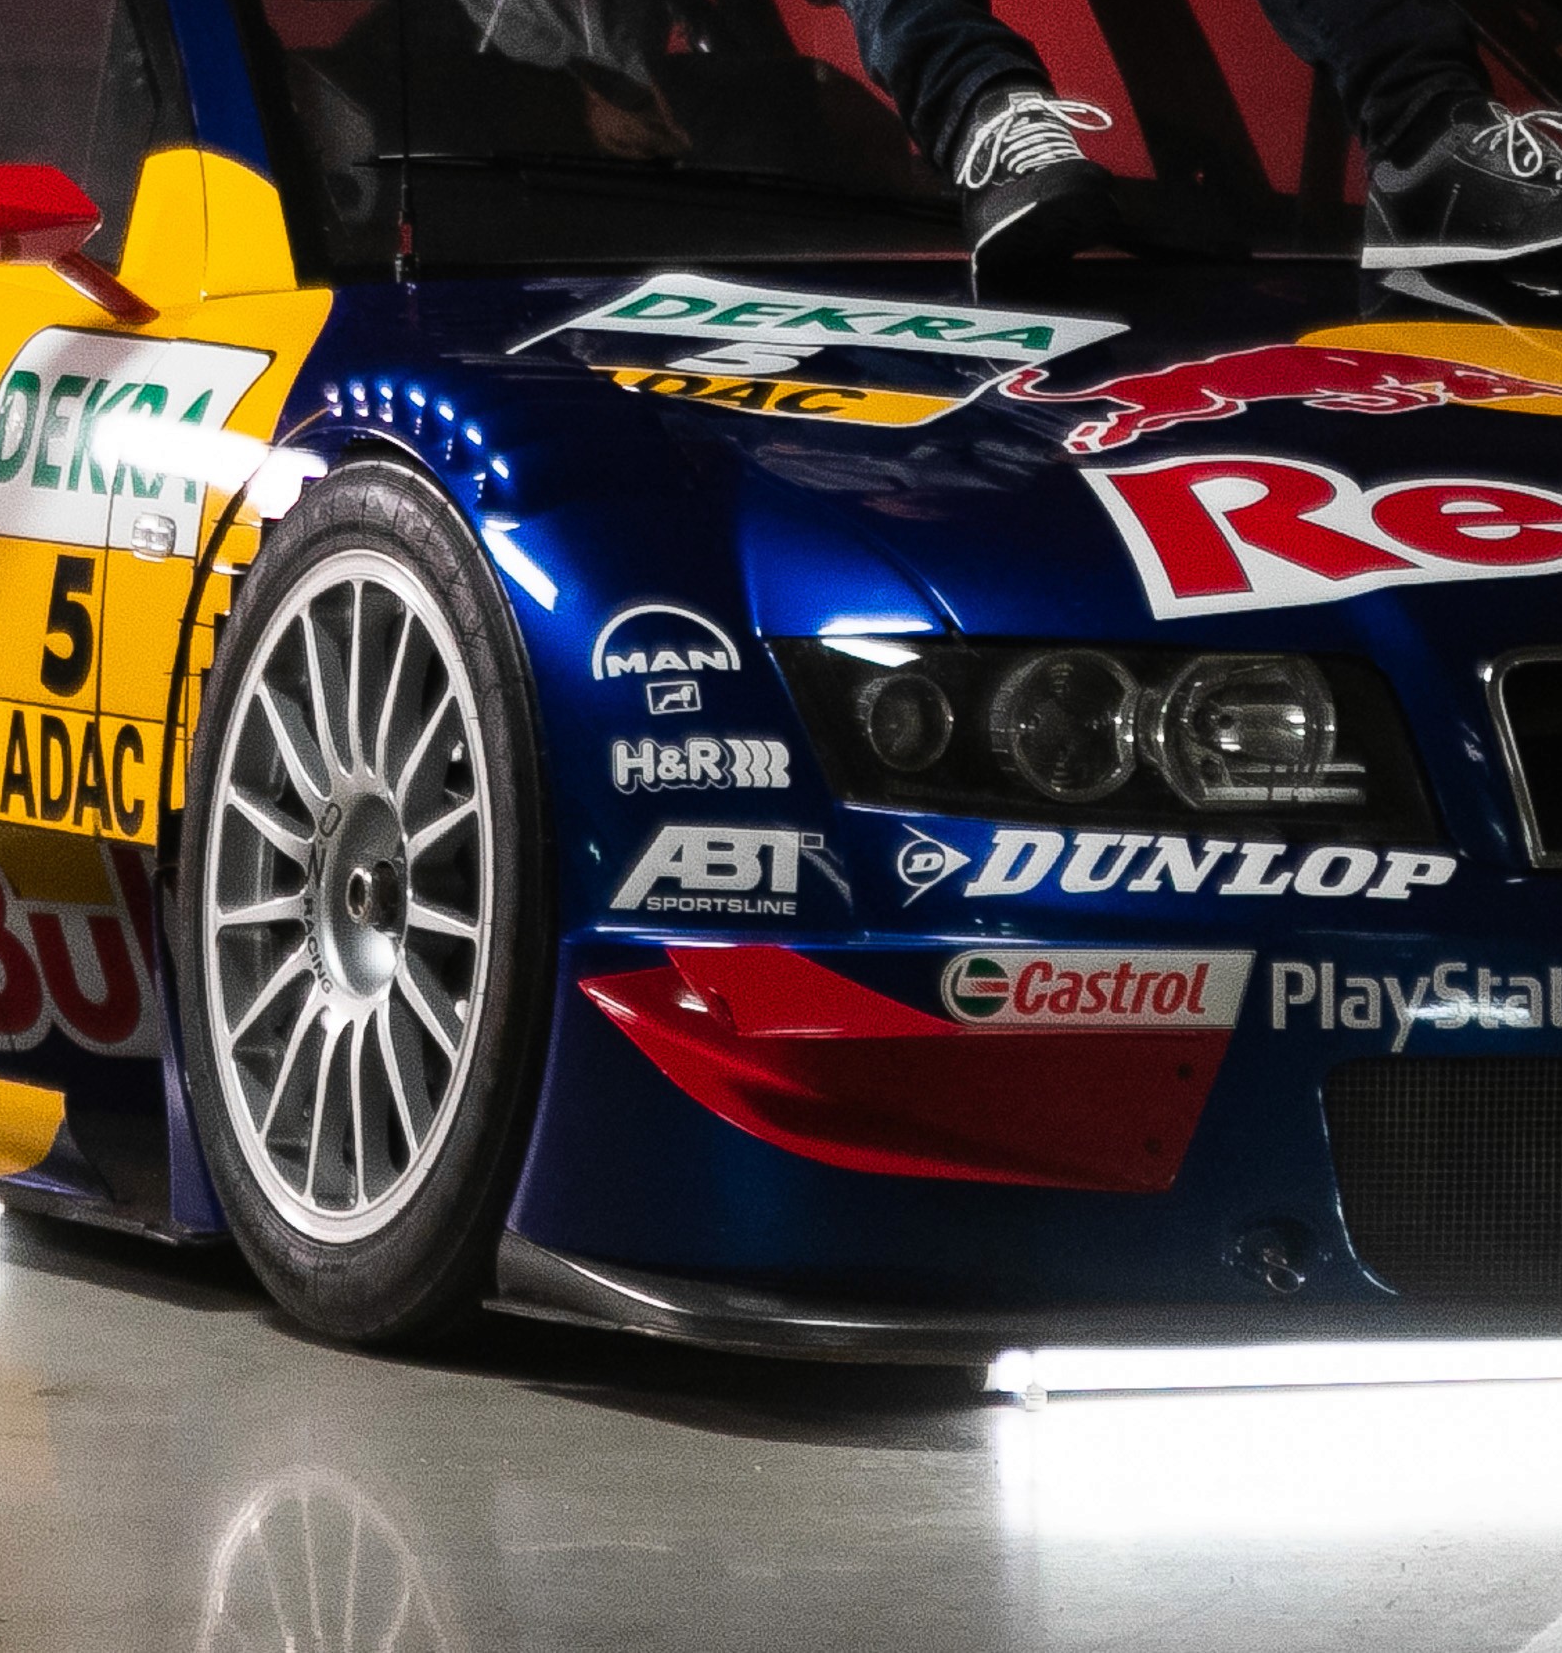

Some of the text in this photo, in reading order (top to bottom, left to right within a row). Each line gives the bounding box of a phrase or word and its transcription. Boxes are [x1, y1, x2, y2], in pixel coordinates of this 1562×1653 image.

[606, 291, 1060, 353] DEKRA
[665, 343, 825, 375] 5
[613, 371, 866, 414] DAC
[39, 554, 95, 698] 5
[606, 647, 740, 676] MAN
[611, 739, 728, 793] H&R
[609, 824, 800, 911] ABT
[965, 829, 1458, 900] DUNLOP
[645, 895, 798, 917] SPORTSLINE
[1012, 960, 1211, 1019] Castrol
